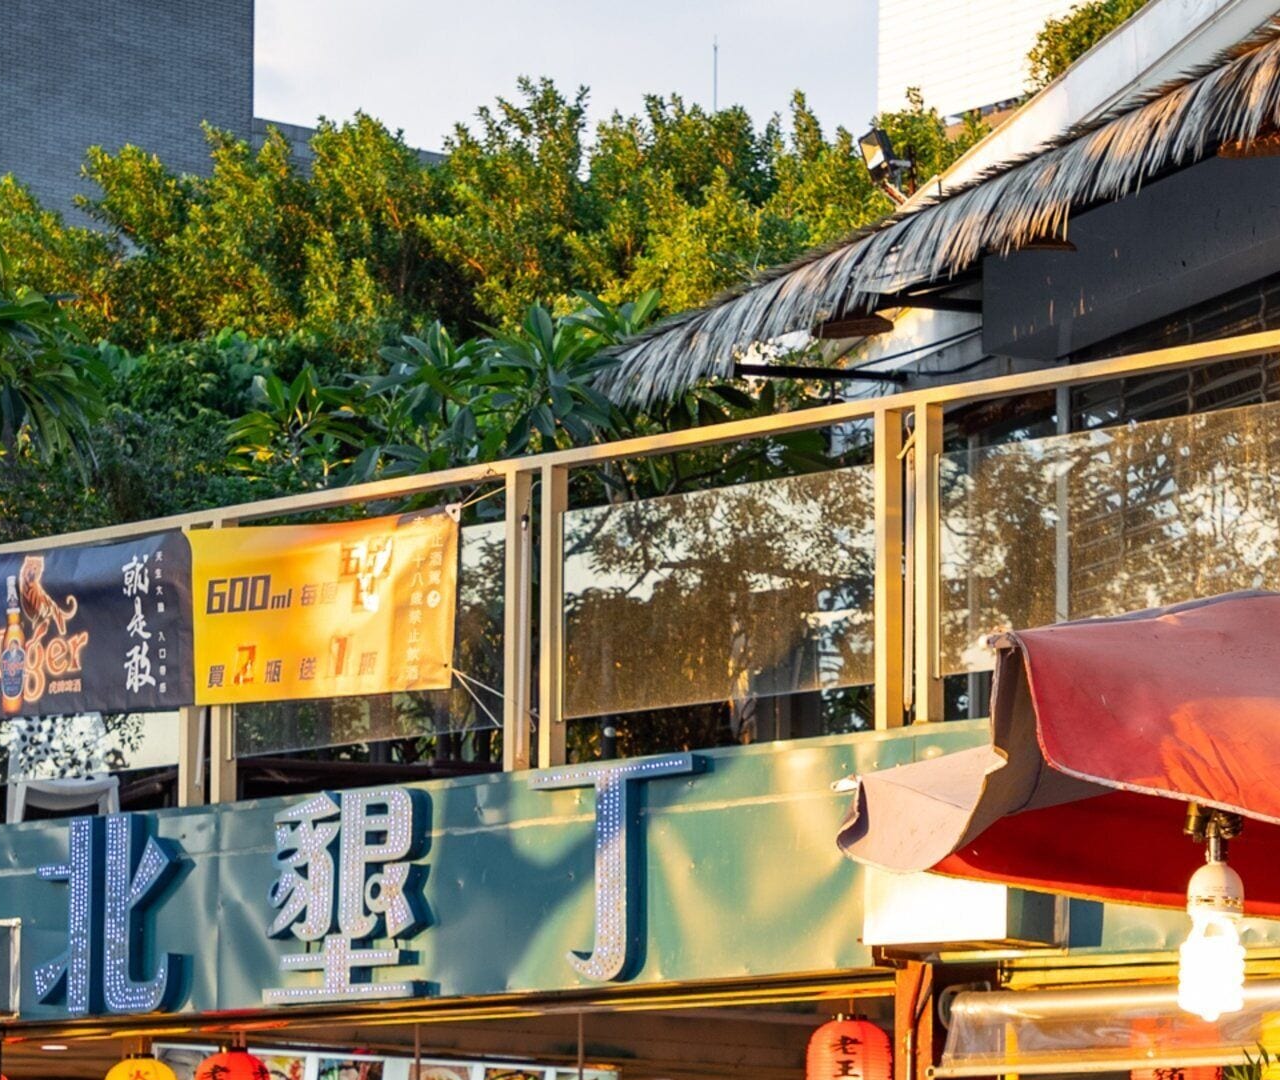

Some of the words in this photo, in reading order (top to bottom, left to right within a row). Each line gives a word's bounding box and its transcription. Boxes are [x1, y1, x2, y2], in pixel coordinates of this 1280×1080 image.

[122, 554, 157, 693] 就是敢
[32, 748, 716, 1014] 北墾丁
